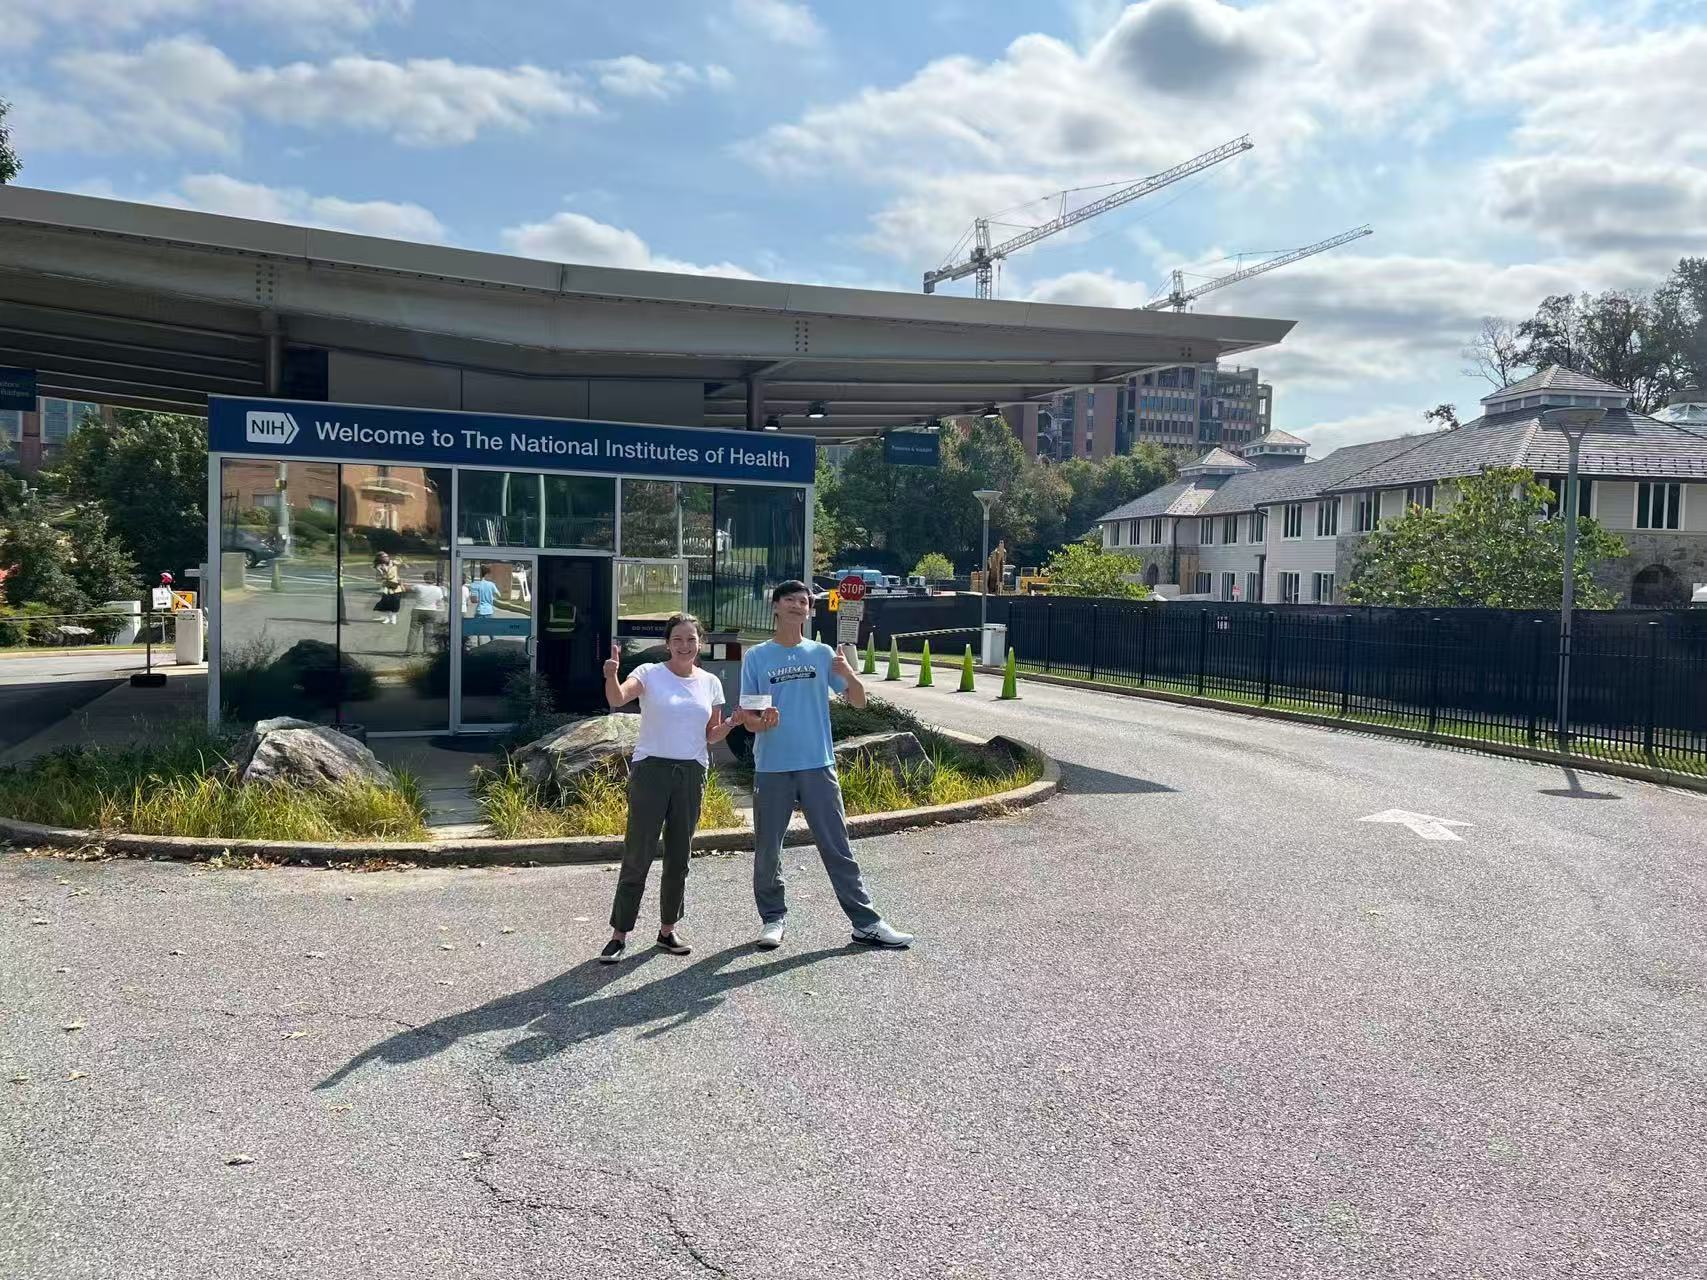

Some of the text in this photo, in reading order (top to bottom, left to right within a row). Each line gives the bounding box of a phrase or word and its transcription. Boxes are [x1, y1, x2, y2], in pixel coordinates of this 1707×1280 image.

[251, 419, 790, 468] NIH Welcome to The National Institutes of Health
[841, 583, 865, 595] STOP
[767, 664, 817, 678] WHITMAN
